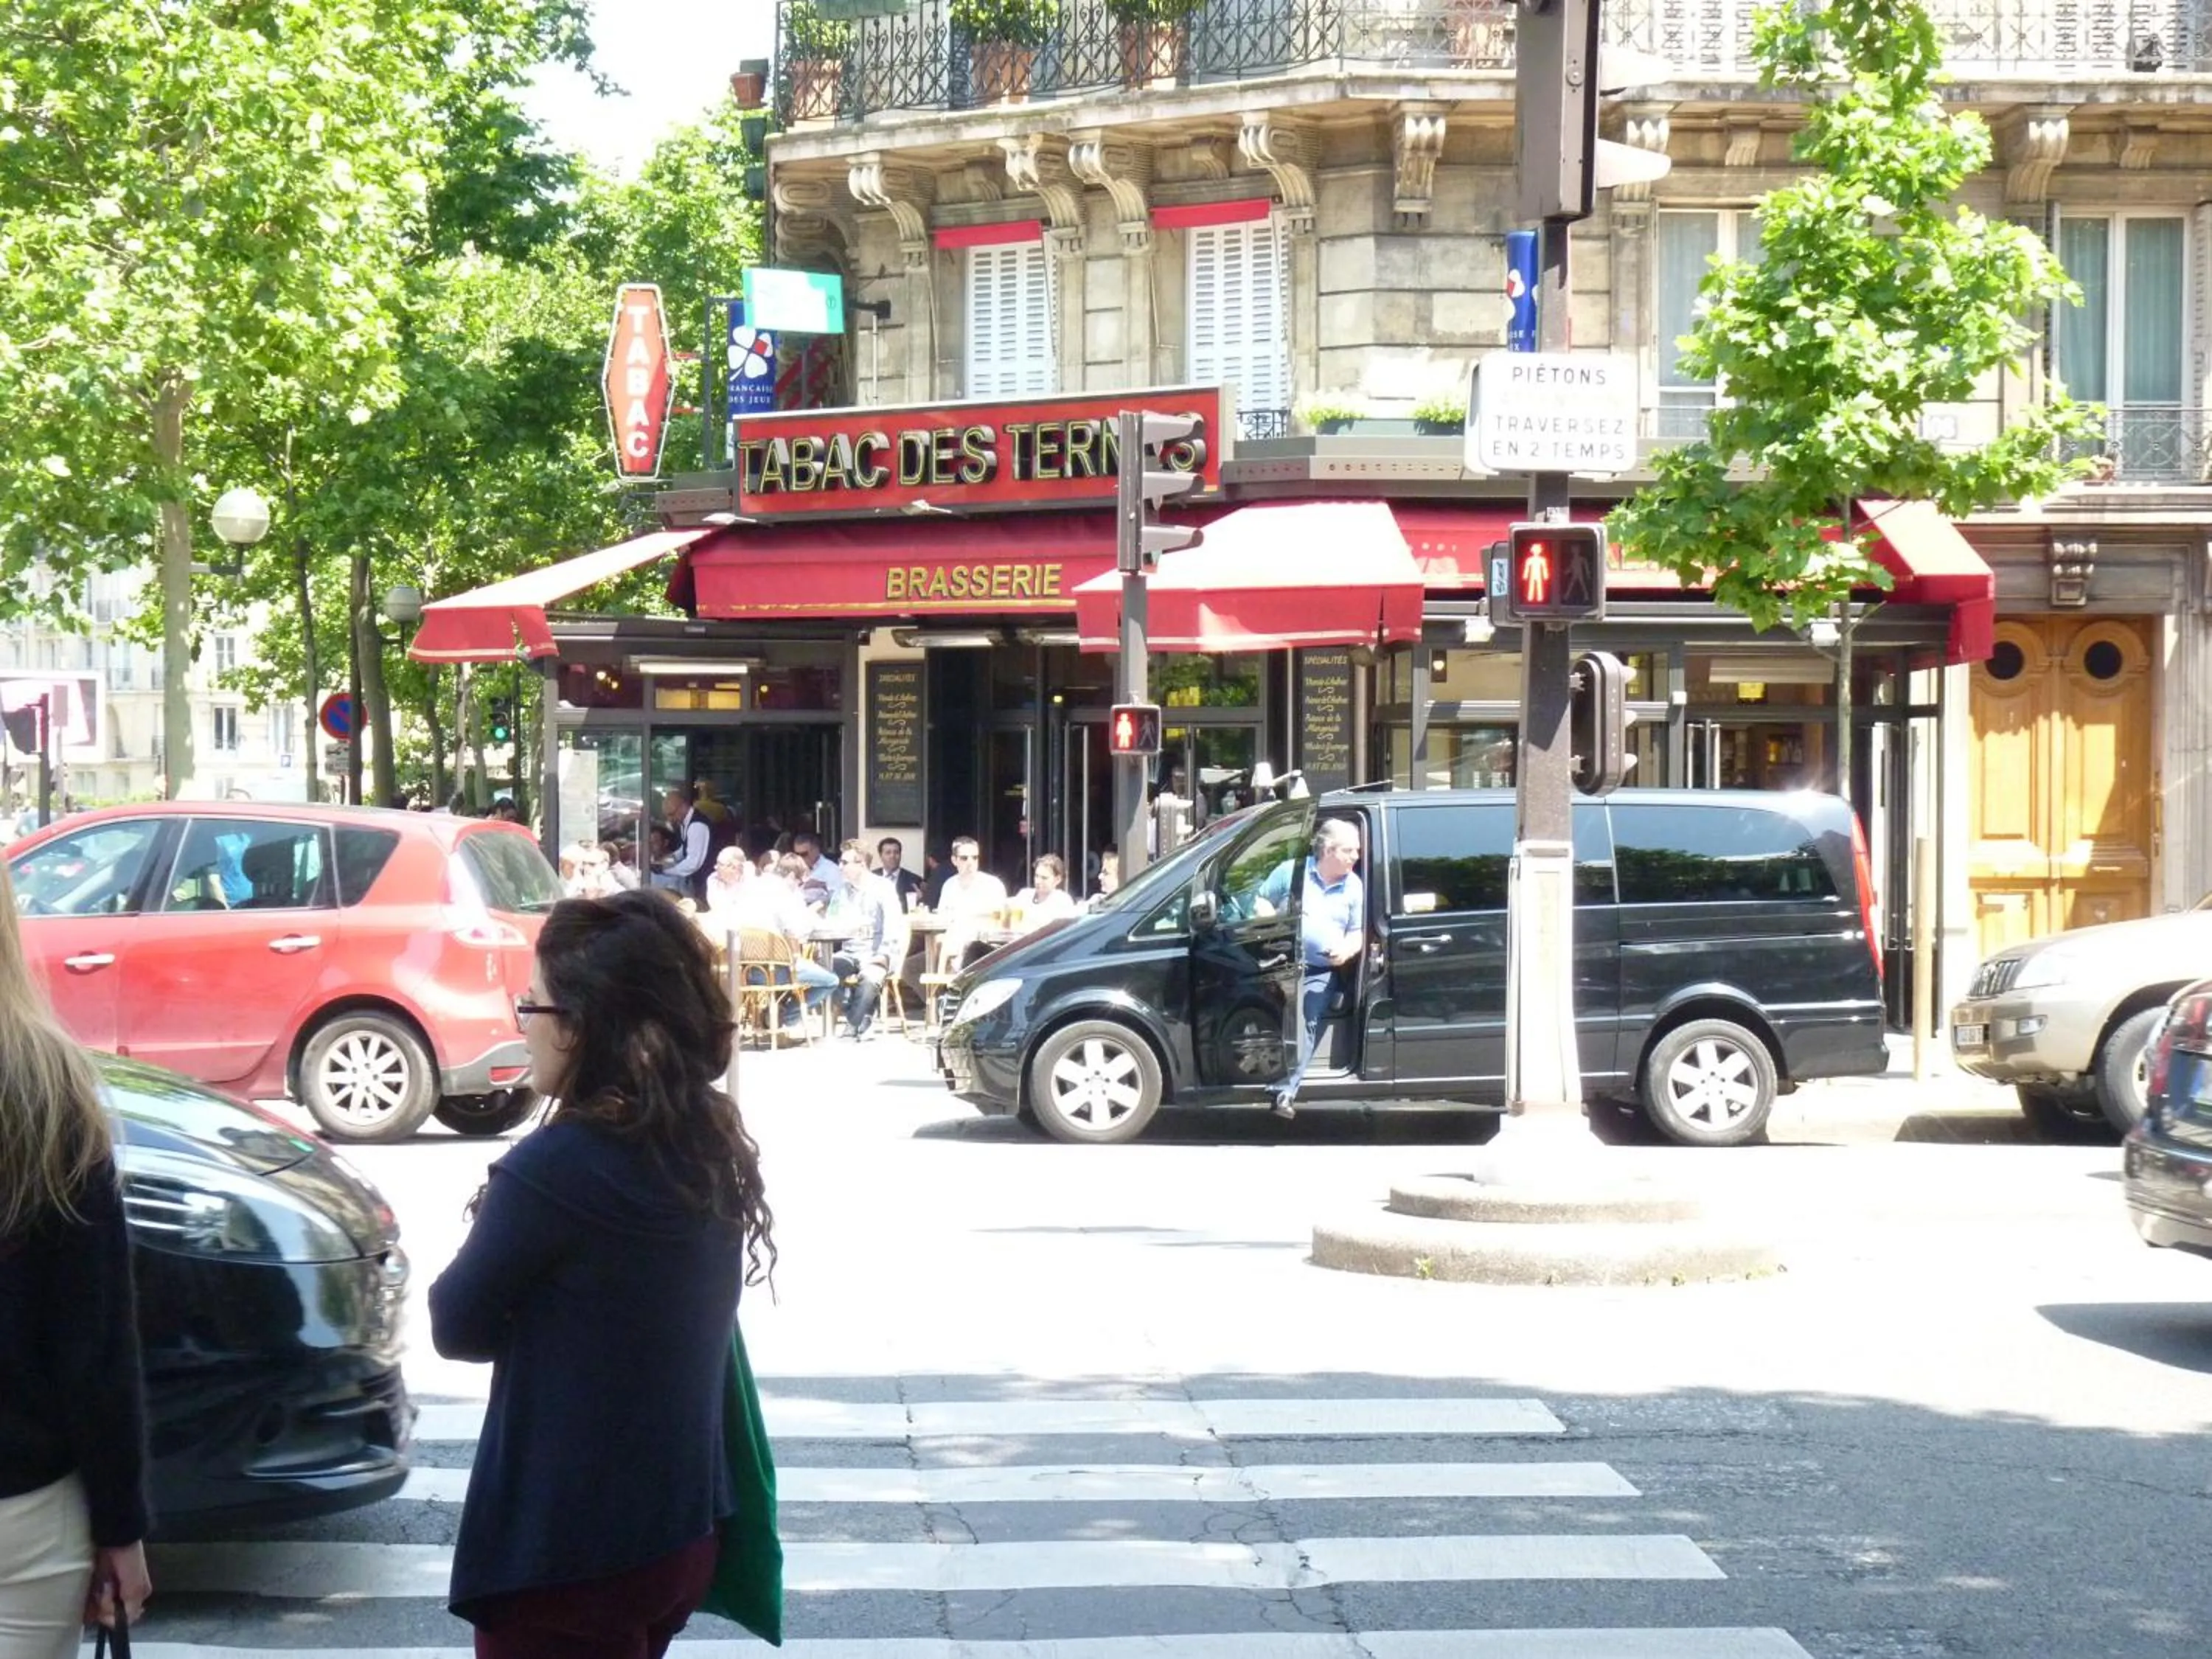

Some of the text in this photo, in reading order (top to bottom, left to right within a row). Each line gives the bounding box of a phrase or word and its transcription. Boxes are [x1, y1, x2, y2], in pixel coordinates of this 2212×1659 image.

[627, 305, 650, 458] TABAC
[1512, 363, 1607, 386] PIÉTONS
[1495, 414, 1624, 435] TRAVERSEZ
[738, 411, 1207, 494] TABAC DES TERNS
[1492, 441, 1625, 460] EN 2 TEMPS
[886, 563, 1063, 599] BRASSERIE
